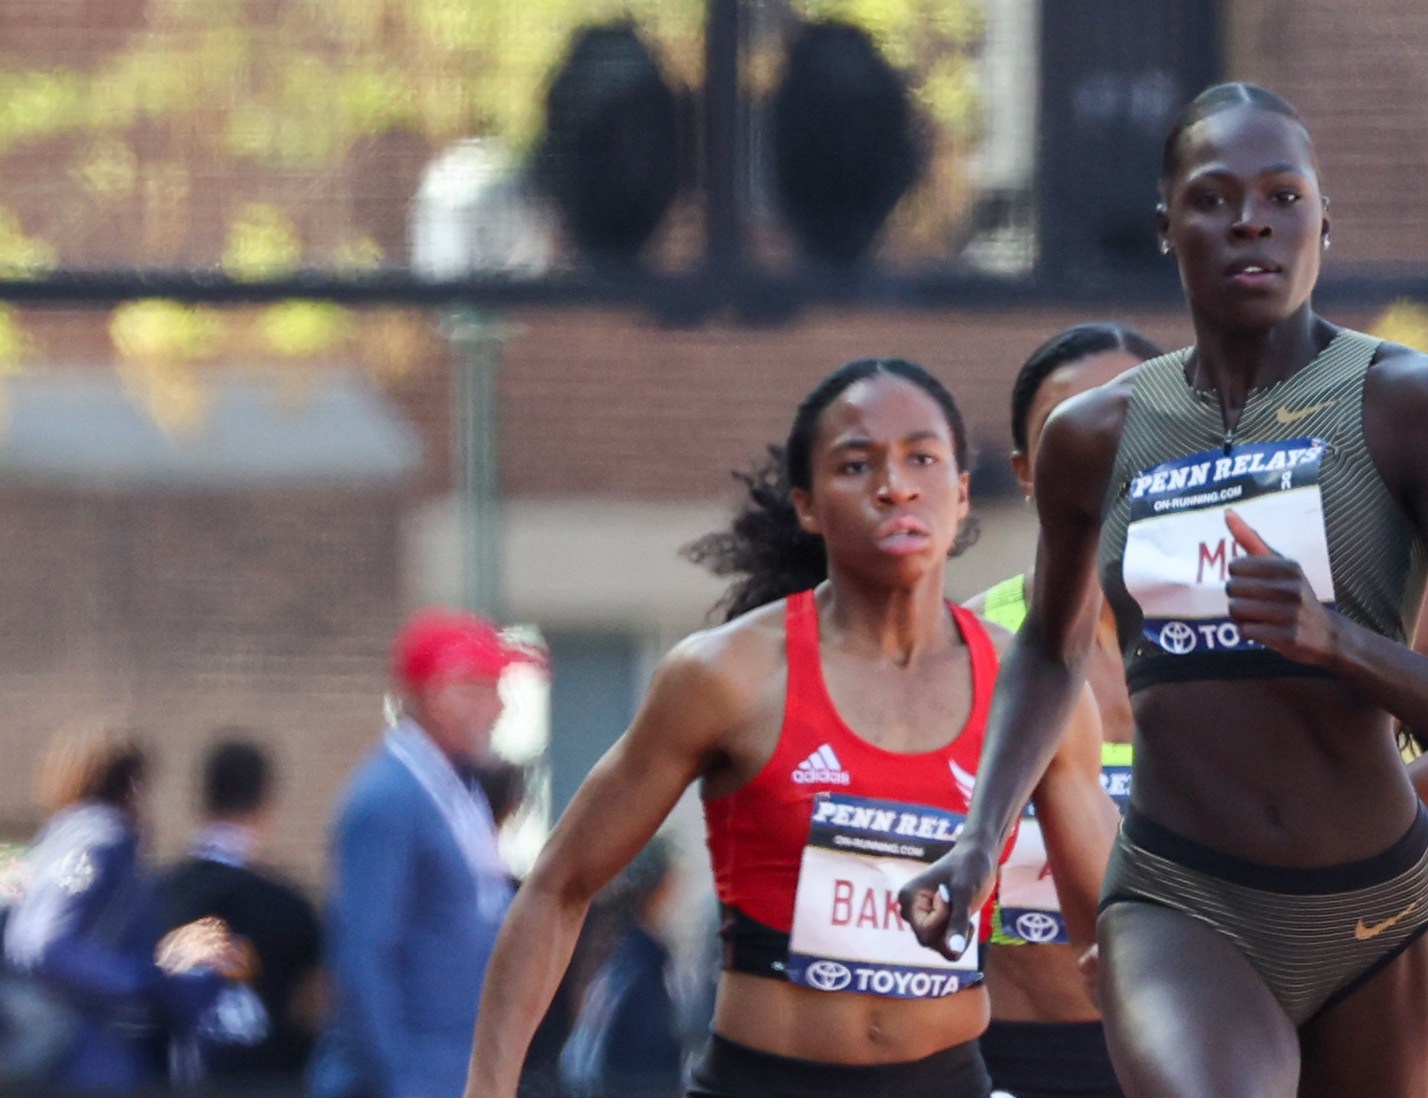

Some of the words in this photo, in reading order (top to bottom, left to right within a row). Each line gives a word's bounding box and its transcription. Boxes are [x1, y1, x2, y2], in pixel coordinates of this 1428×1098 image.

[1132, 462, 1212, 498] PENN
[1213, 446, 1323, 483] RELAYS
[1154, 485, 1243, 513] ON-RUNNING.COM
[791, 769, 850, 786] adidas
[812, 801, 898, 832] PENN
[855, 967, 960, 997] TOYOTA
